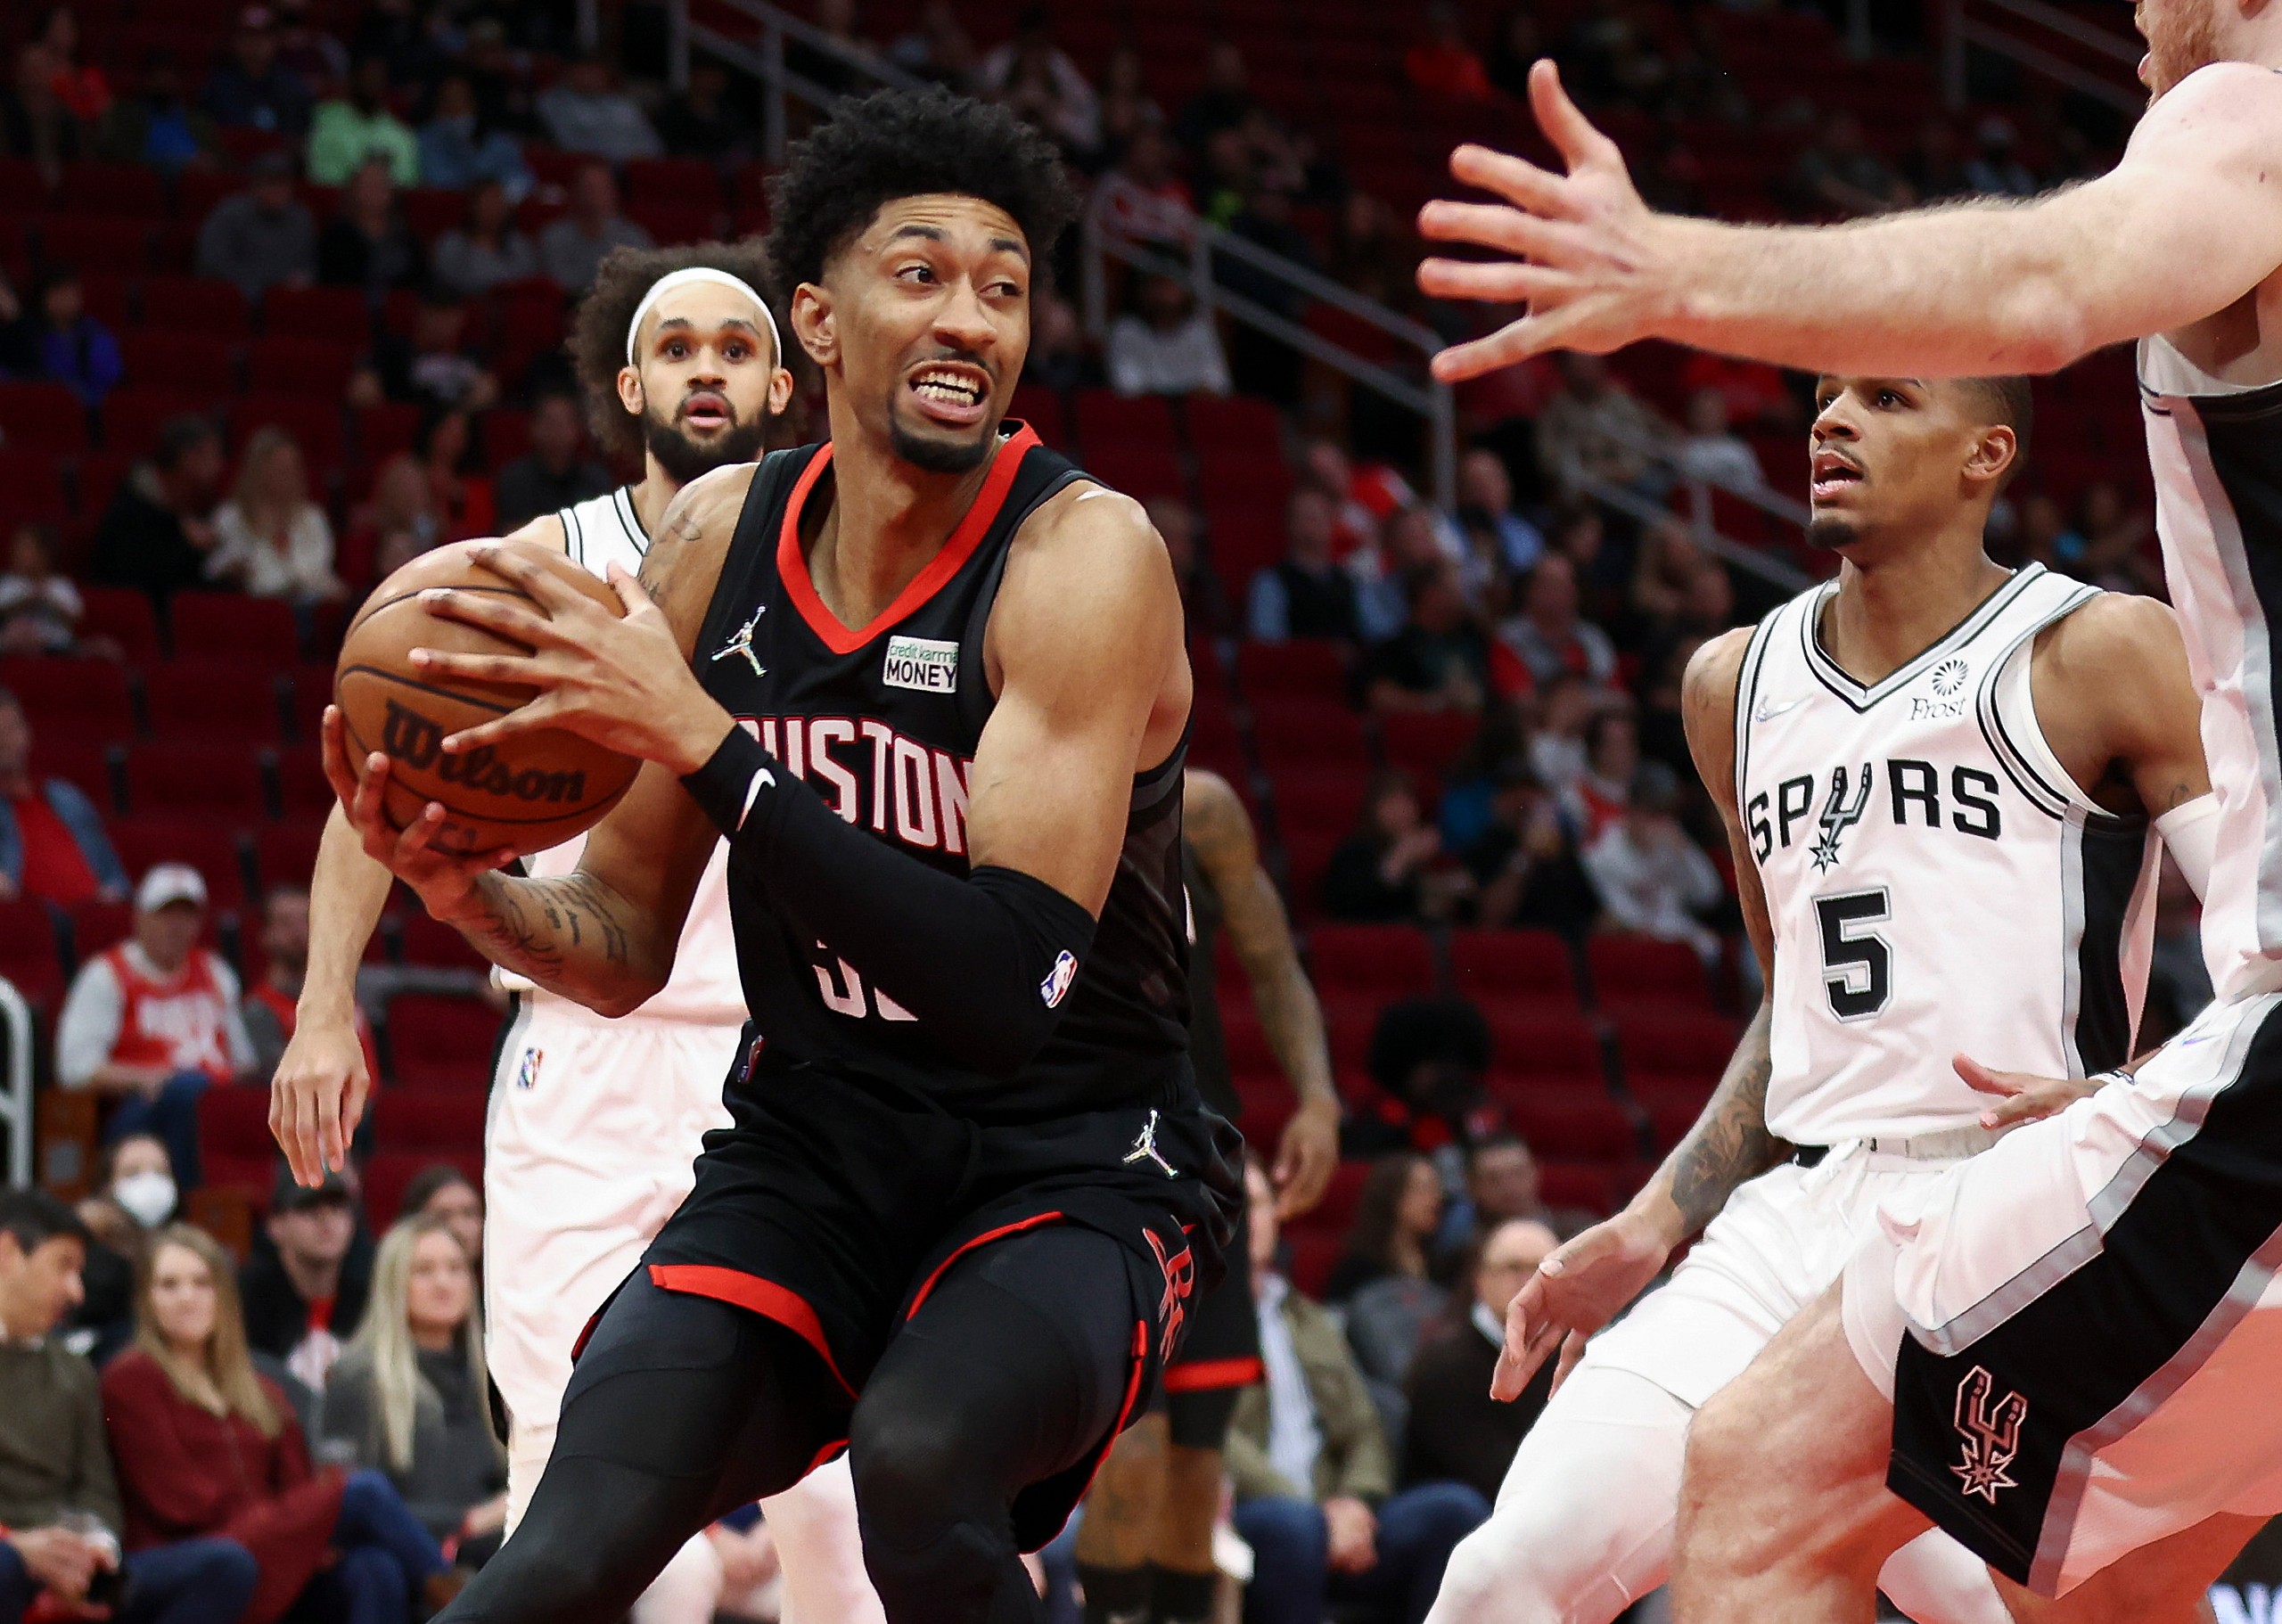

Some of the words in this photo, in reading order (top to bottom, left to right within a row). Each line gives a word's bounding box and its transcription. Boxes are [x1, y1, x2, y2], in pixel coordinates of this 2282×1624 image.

[886, 658, 957, 688] MONEY
[890, 643, 918, 659] credit
[382, 698, 587, 803] Wilson
[1908, 695, 1966, 721] Frost
[732, 715, 974, 857] USTON
[1747, 759, 2002, 876] SPURS
[1810, 885, 1893, 1023] 5
